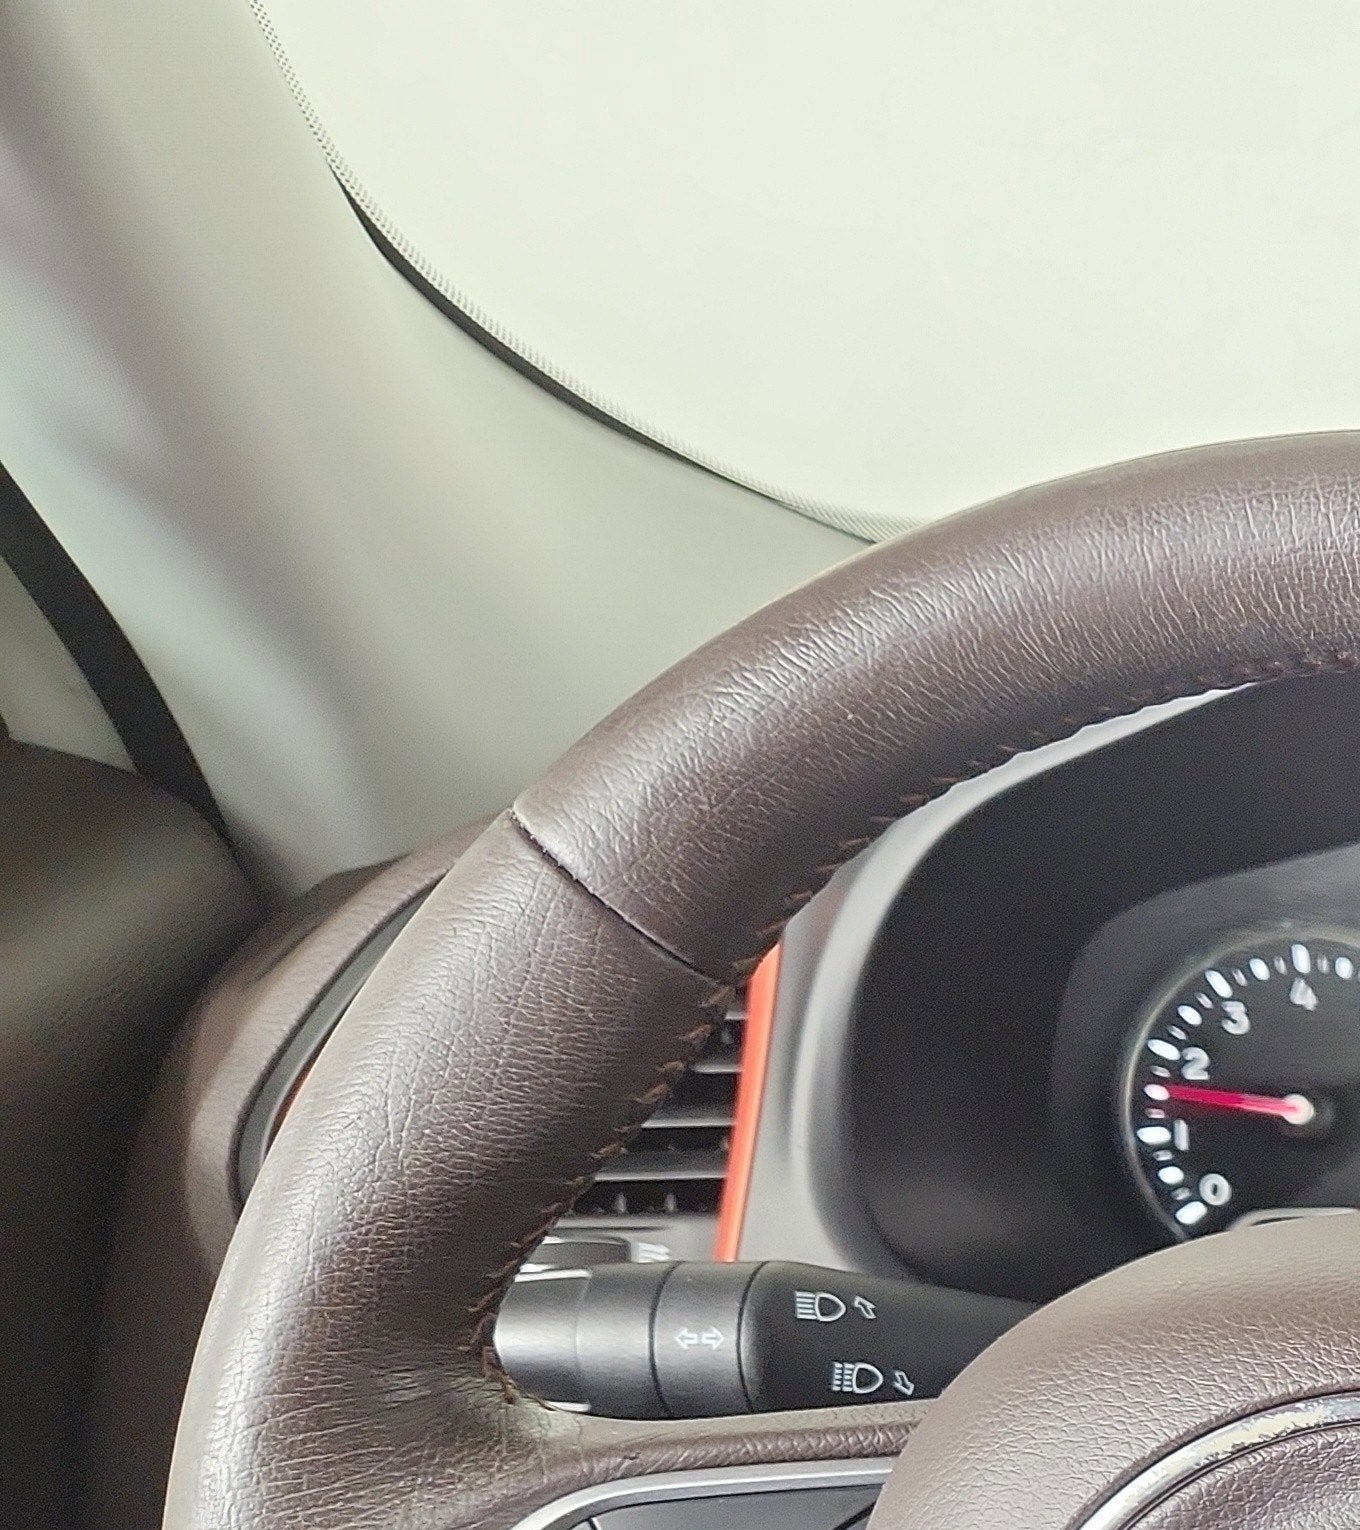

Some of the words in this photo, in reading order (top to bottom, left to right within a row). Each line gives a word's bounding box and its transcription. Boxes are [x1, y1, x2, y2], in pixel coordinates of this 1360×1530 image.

[1221, 1000, 1250, 1035] 3
[1180, 1047, 1210, 1080] 2
[1200, 1172, 1232, 1206] 0
